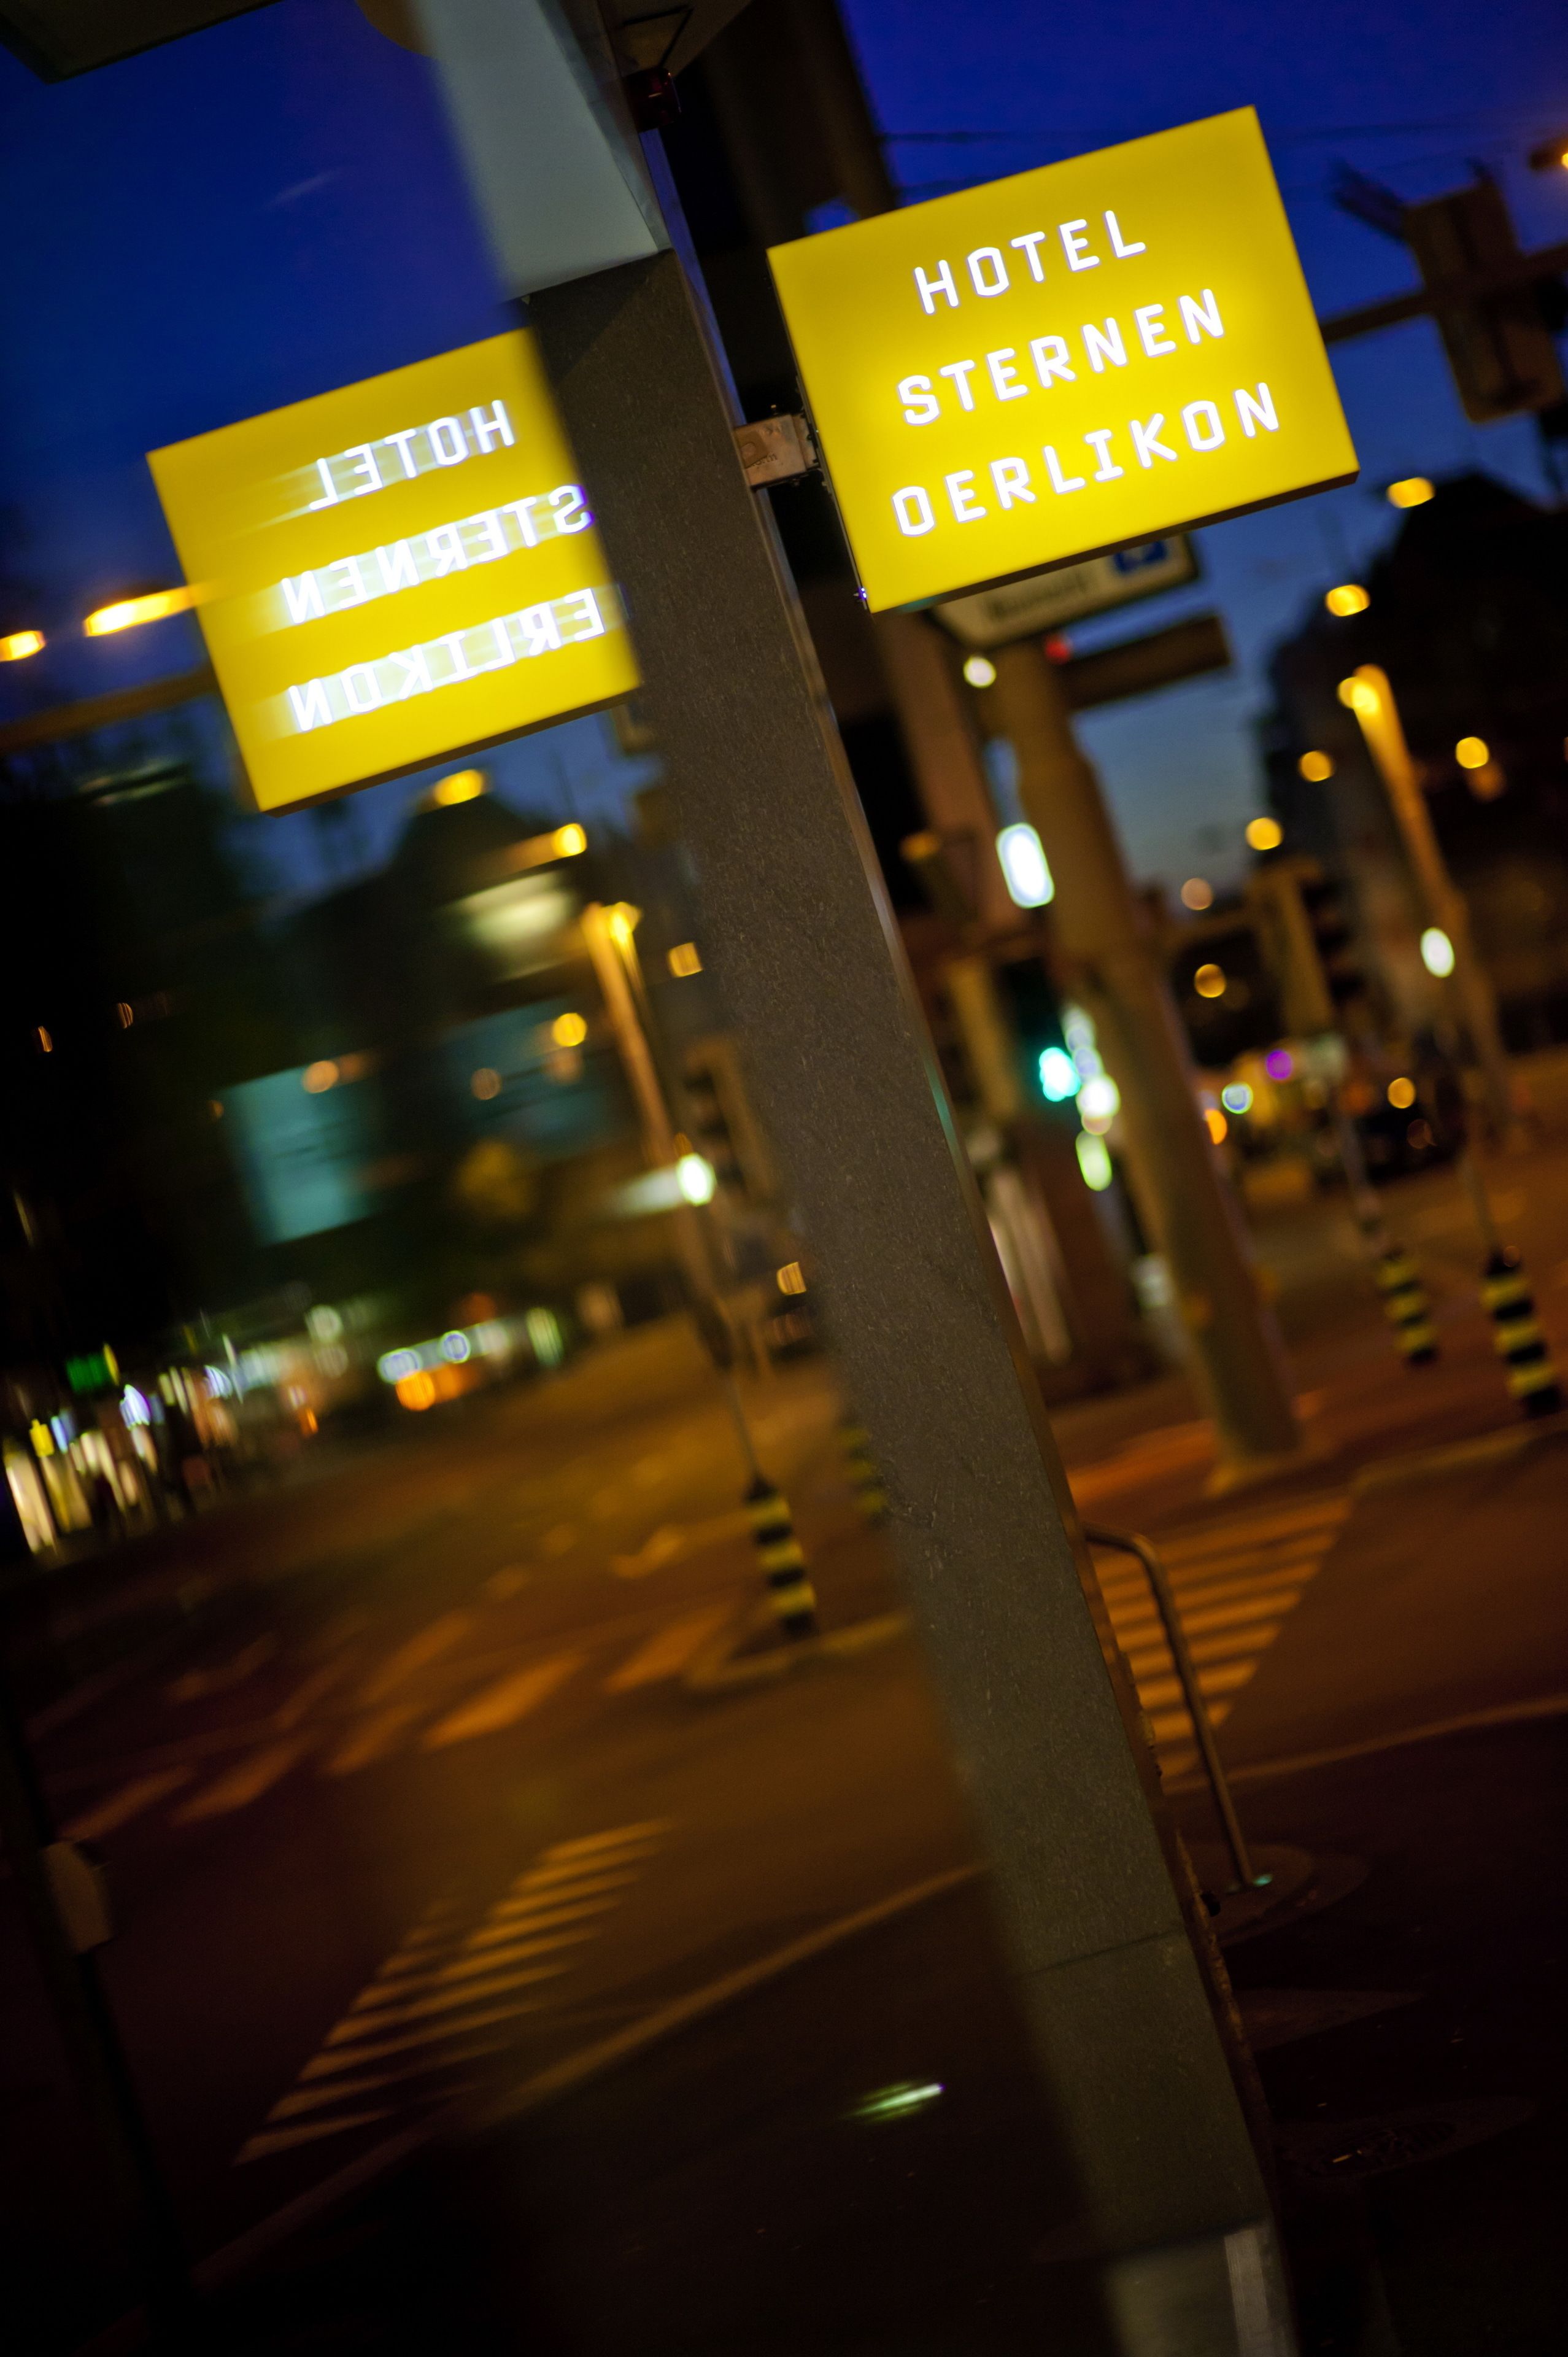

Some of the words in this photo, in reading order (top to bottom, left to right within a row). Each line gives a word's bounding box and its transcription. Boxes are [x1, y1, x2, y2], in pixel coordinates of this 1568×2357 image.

[913, 211, 1146, 315] HOTEL
[897, 289, 1224, 426] STERNEN
[892, 383, 1279, 537] OERLIKON
